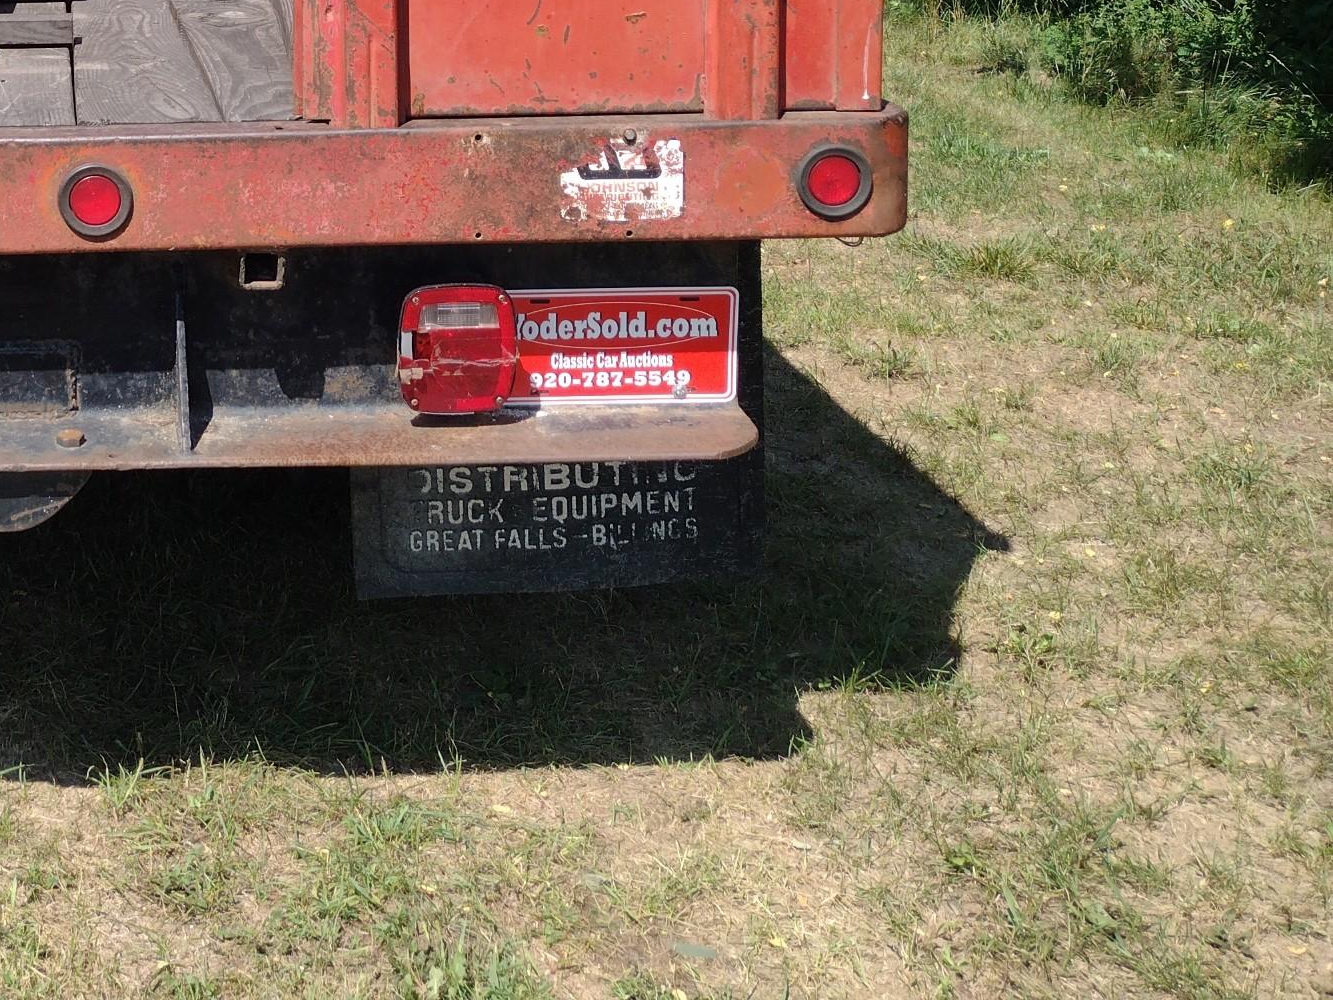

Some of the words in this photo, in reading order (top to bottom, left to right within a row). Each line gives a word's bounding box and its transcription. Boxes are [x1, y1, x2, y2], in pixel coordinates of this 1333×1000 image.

[587, 181, 659, 193] OHNSON
[550, 352, 594, 370] Classic
[596, 352, 619, 369] Car
[620, 350, 674, 369] Auctions
[529, 370, 691, 389] 920-787-5549
[417, 498, 505, 525] RUCK
[532, 487, 697, 524] EQUIPMENT
[409, 529, 484, 552] GREAT
